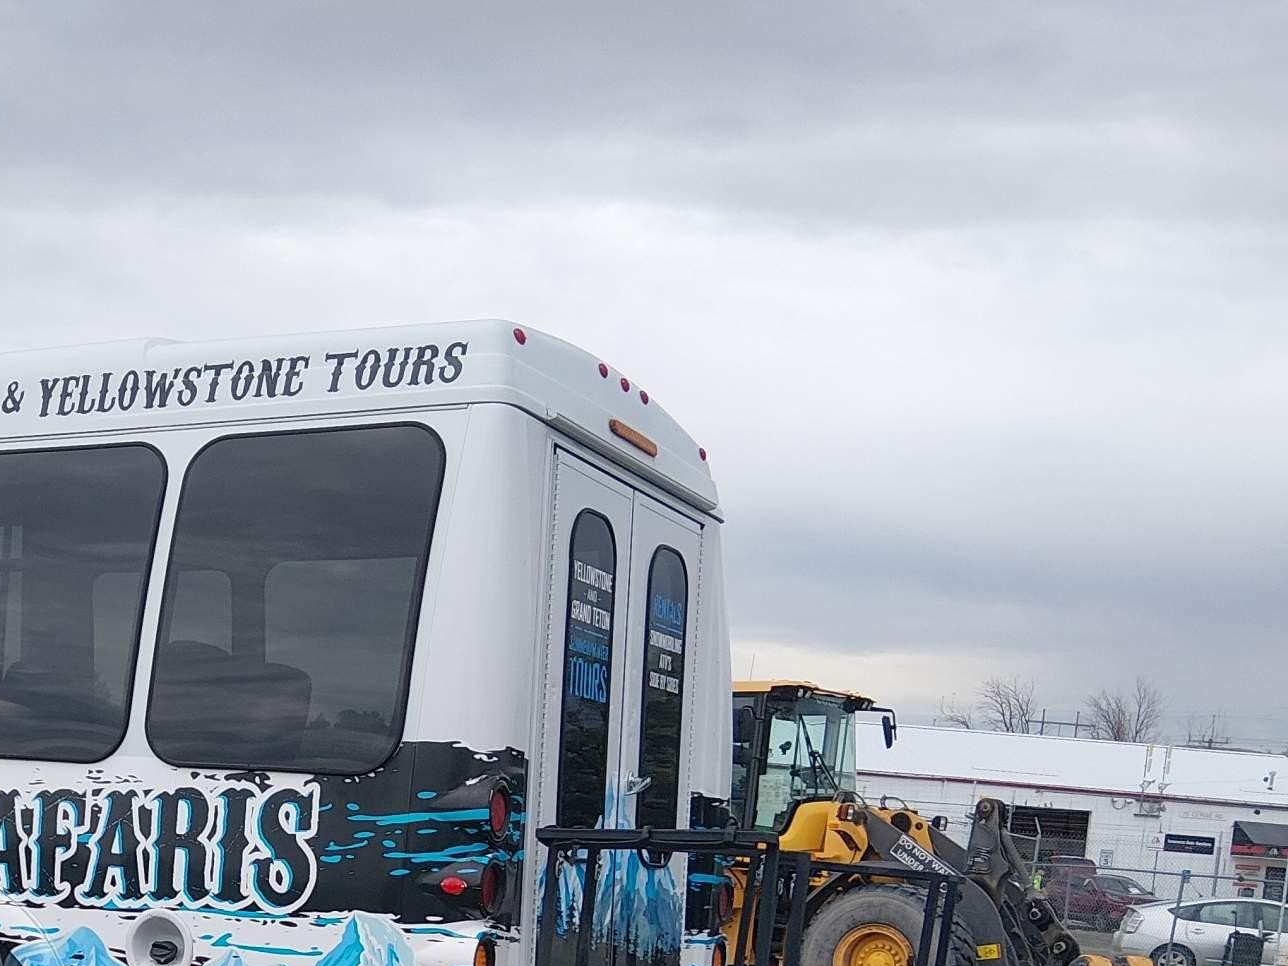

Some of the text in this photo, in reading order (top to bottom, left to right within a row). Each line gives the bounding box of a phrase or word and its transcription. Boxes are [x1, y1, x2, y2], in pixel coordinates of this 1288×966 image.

[1, 381, 25, 414] &
[38, 355, 311, 418] YELLOWSTONE
[324, 341, 469, 393] TOURS
[573, 559, 613, 593] YELLOWSTONE
[587, 588, 598, 603] AND
[571, 599, 611, 631] GRAND TETON
[569, 655, 608, 704] TOURS
[899, 838, 913, 850] DO
[912, 848, 932, 864] NOT
